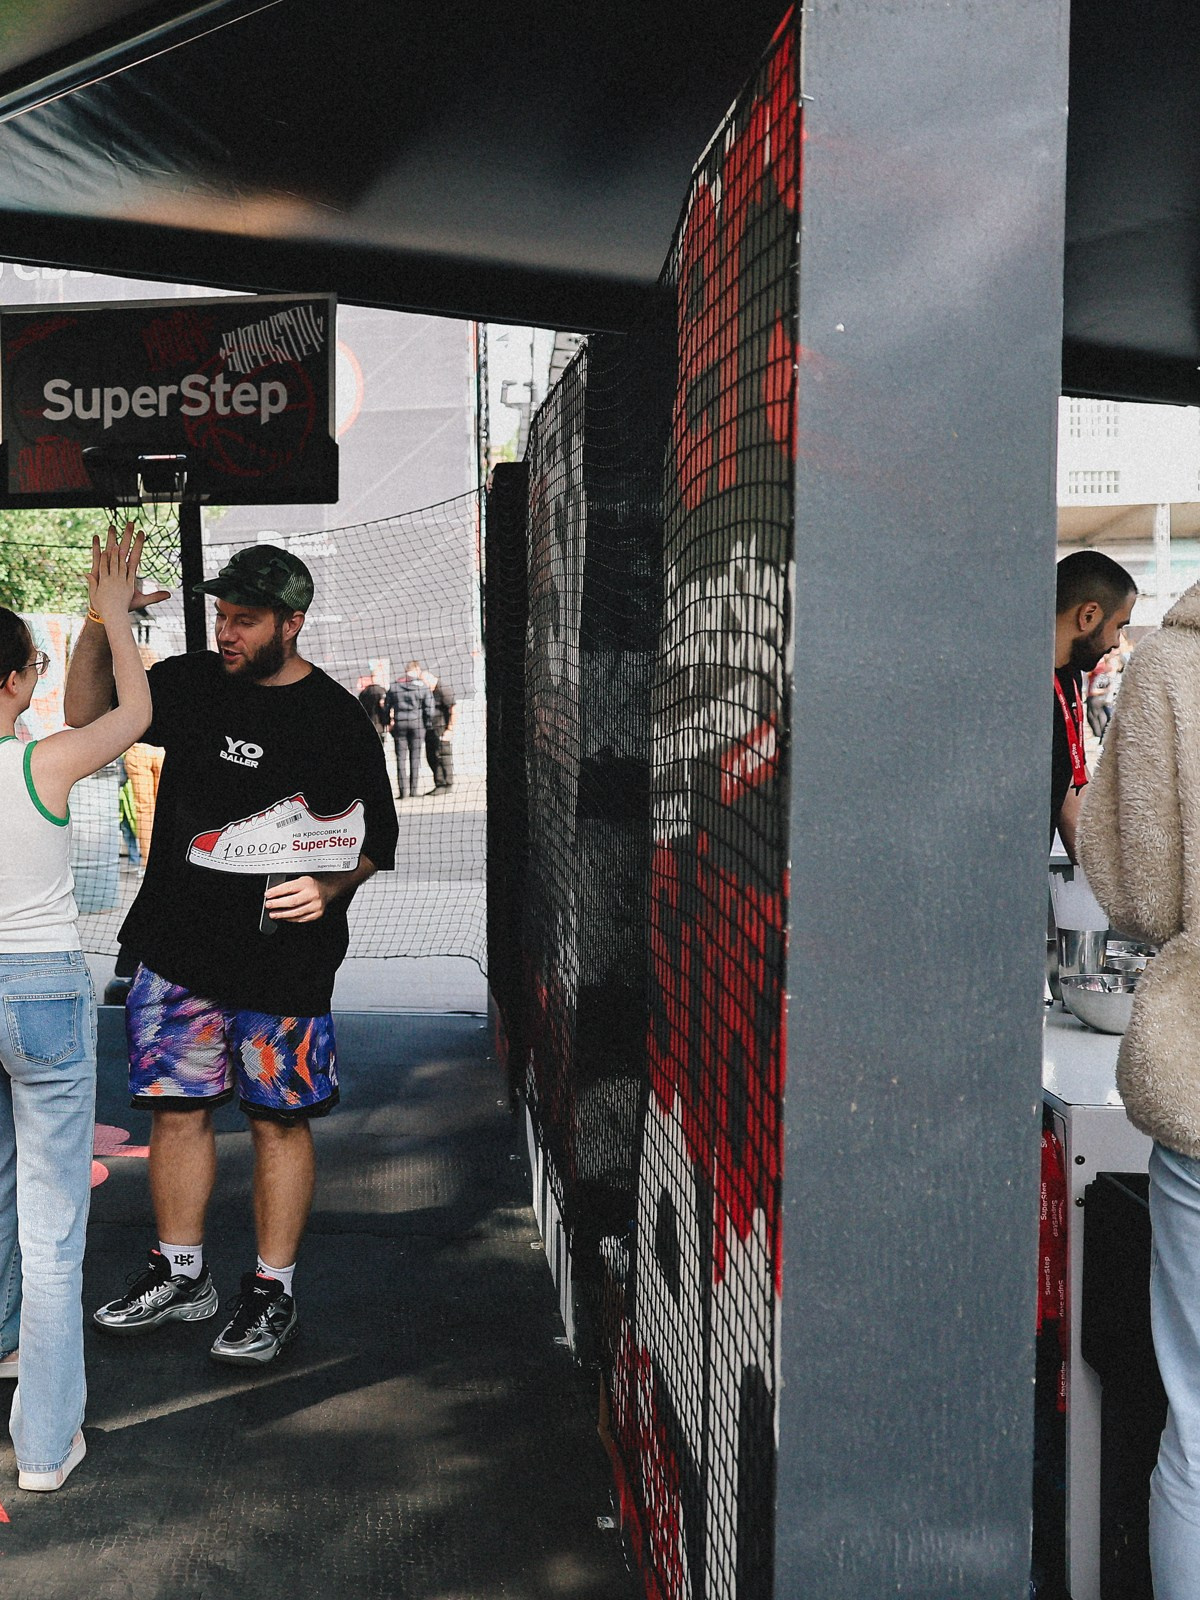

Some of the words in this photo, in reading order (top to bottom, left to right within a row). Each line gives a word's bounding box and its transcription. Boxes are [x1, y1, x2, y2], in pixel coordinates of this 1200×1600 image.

[42, 372, 288, 430] SuperStep
[225, 735, 264, 759] YO
[220, 750, 259, 769] BALLER
[303, 829, 342, 838] кроссовки
[292, 835, 357, 852] SuperStep
